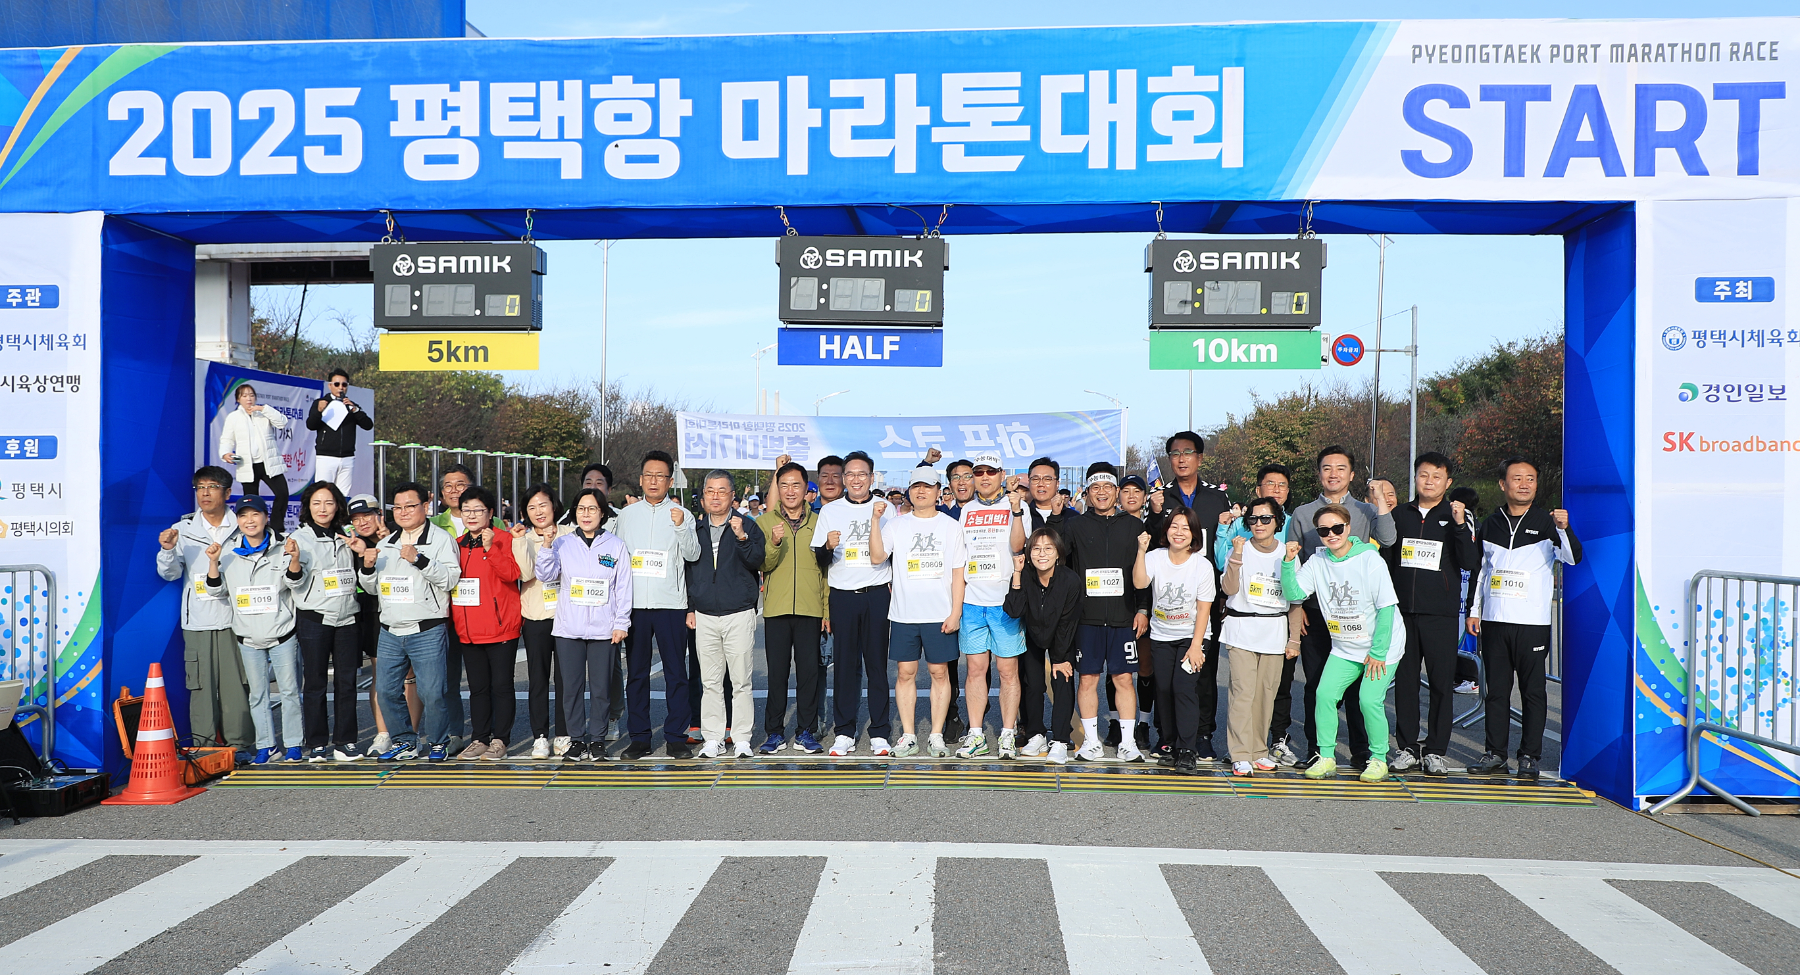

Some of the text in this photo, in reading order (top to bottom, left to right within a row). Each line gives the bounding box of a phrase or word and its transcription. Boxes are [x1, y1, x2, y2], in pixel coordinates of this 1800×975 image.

[1411, 41, 1780, 64] PYEONGTAEK PORT MARATHON RACE
[108, 65, 1245, 181] 2025 평택항 마라톤대회
[1400, 81, 1786, 179] START
[417, 256, 512, 274] SAMIK
[825, 249, 924, 268] SAMIK
[1199, 251, 1302, 270] SAMIK
[6, 287, 42, 307] 주관
[1713, 280, 1753, 301] 주최
[427, 340, 489, 363] 5km
[819, 334, 901, 360] HALF
[1192, 338, 1278, 363] 10km
[1702, 383, 1788, 403] 경인일보
[4, 438, 40, 458] 후원
[1662, 431, 1696, 452] SK
[11, 482, 62, 500] 평택시
[966, 513, 1008, 526] 수능대박!
[10, 520, 74, 537] 평택시의회
[1416, 550, 1436, 559] 1074
[645, 559, 663, 568] 1005
[920, 560, 943, 569] 50809
[979, 563, 997, 572] 1024
[392, 585, 410, 593] 1036
[1102, 578, 1120, 586] 1027
[1249, 584, 1283, 597] 5km 1067
[1503, 579, 1524, 588] 1010
[252, 595, 272, 604] 1019
[459, 588, 476, 596] 1015
[543, 593, 556, 601] 5km
[586, 588, 605, 597] 1022
[1342, 623, 1362, 632] 1068
